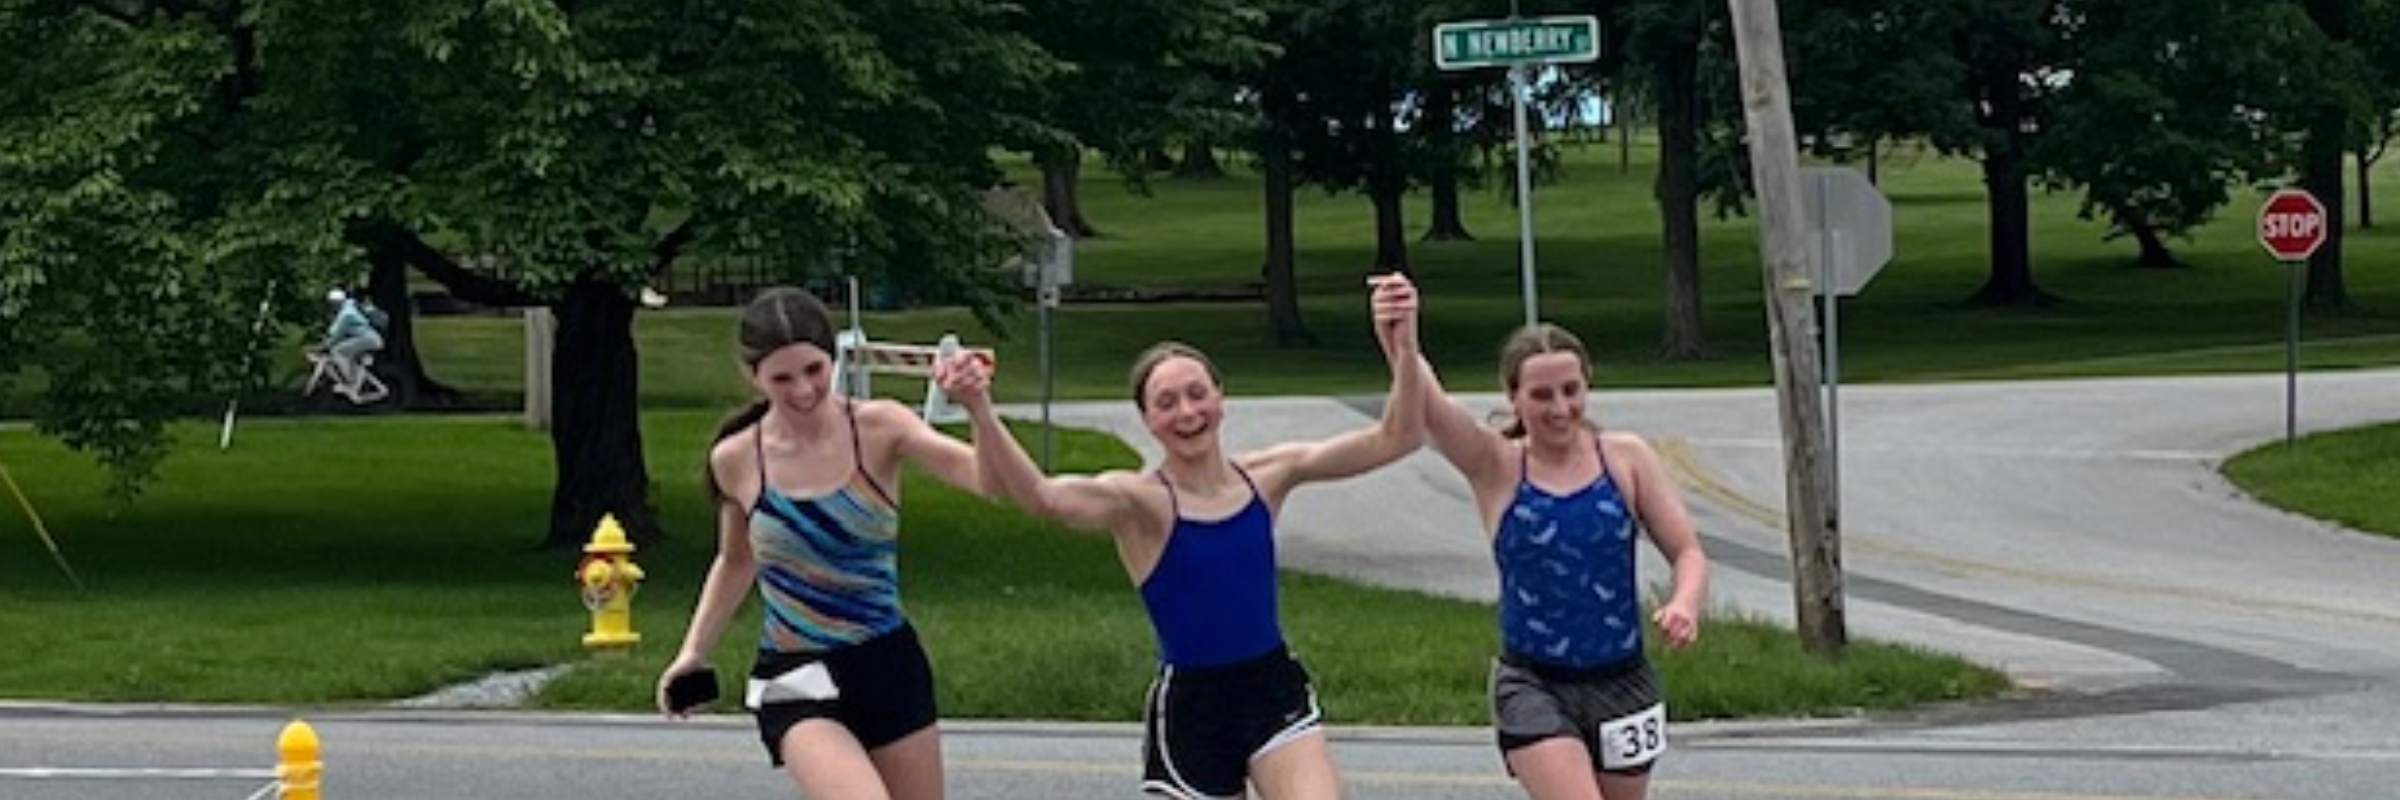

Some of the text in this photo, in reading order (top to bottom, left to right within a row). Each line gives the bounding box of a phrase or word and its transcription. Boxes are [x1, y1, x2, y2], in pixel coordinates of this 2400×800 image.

[1443, 33, 1457, 58] N
[2264, 212, 2318, 237] STOP
[1621, 717, 1659, 757] 38
